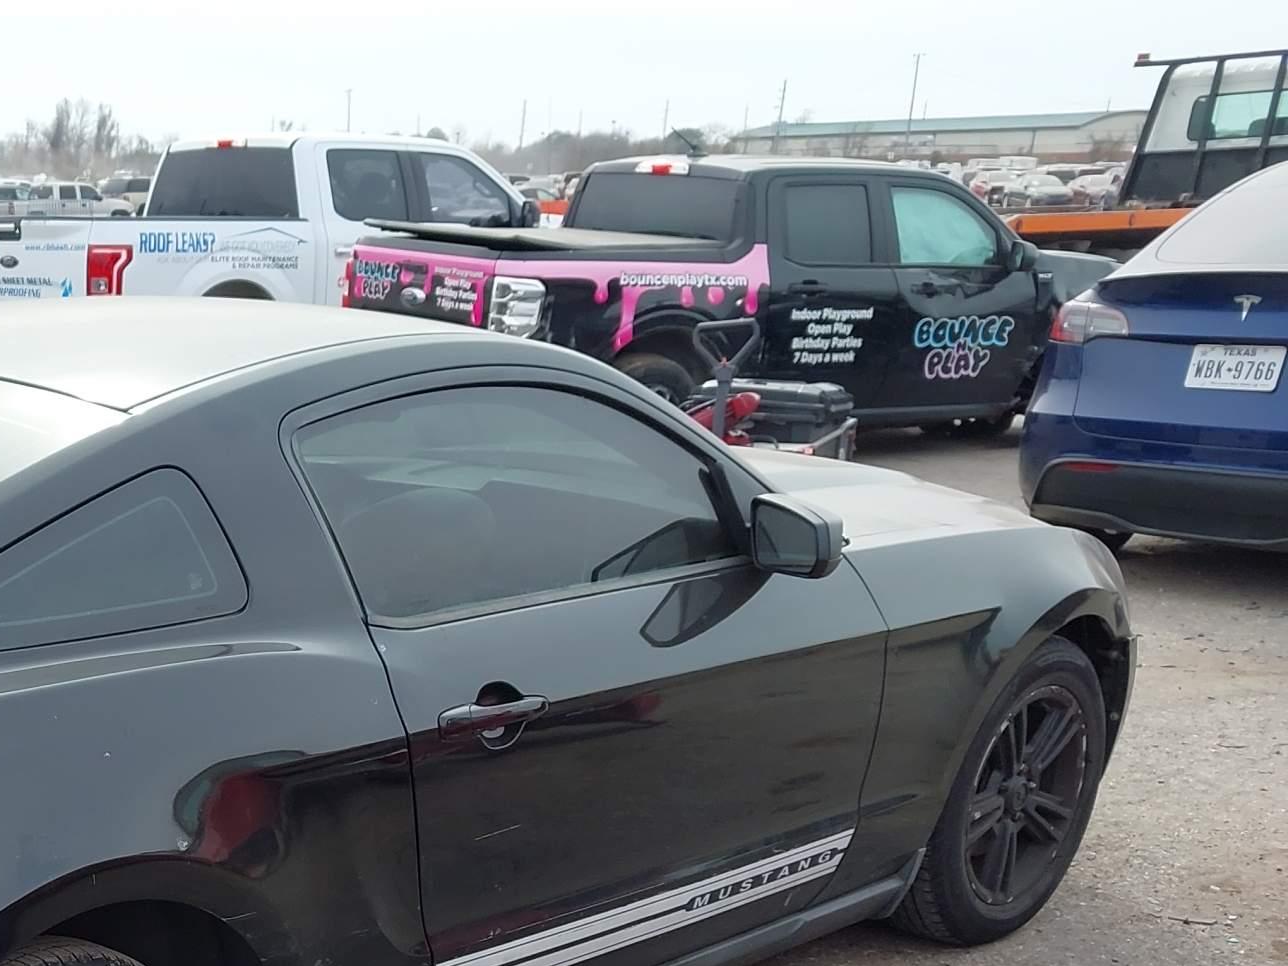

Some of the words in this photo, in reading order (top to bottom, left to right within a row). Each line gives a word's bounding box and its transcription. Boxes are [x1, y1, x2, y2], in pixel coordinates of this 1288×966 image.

[139, 232, 174, 253] ROOF
[175, 232, 216, 253] LEAKS?
[355, 260, 401, 282] BOUNCE
[619, 272, 748, 287] bouncenplaytx.com
[361, 278, 392, 299] PLAY
[790, 307, 822, 320] Indoor
[821, 306, 874, 321] Playground
[807, 322, 832, 336] Open
[832, 322, 854, 336] Play
[913, 315, 1015, 348] BOUNCE
[791, 336, 830, 350] Birthday
[830, 336, 863, 348] Parties
[1223, 347, 1257, 357] TEXAS
[792, 351, 801, 363] 7
[800, 351, 823, 365] Days
[823, 353, 830, 363] a
[831, 350, 856, 363] week
[923, 345, 991, 380] PLAY
[693, 850, 832, 910] MUSTANG
